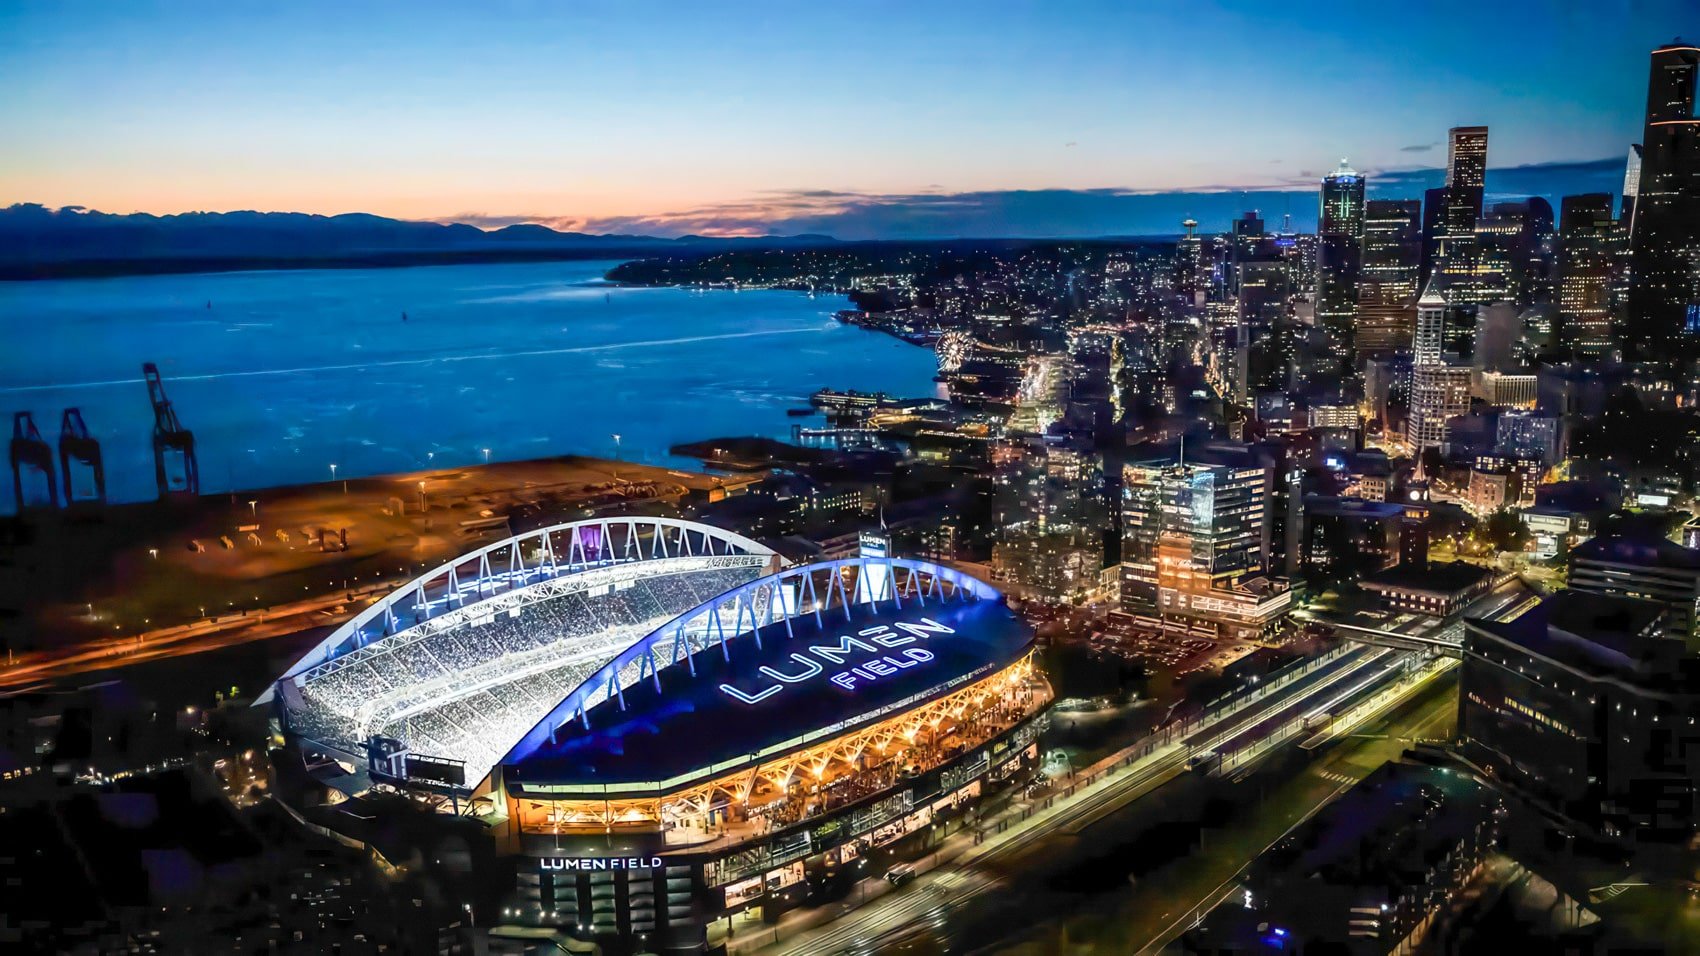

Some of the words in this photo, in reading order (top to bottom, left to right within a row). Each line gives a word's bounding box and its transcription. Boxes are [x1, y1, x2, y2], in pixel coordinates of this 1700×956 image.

[860, 535, 886, 545] LUMEN
[719, 617, 956, 704] LUMEN
[830, 648, 935, 690] FIELD
[540, 858, 606, 870] LUMEN
[610, 857, 662, 869] FIELD
